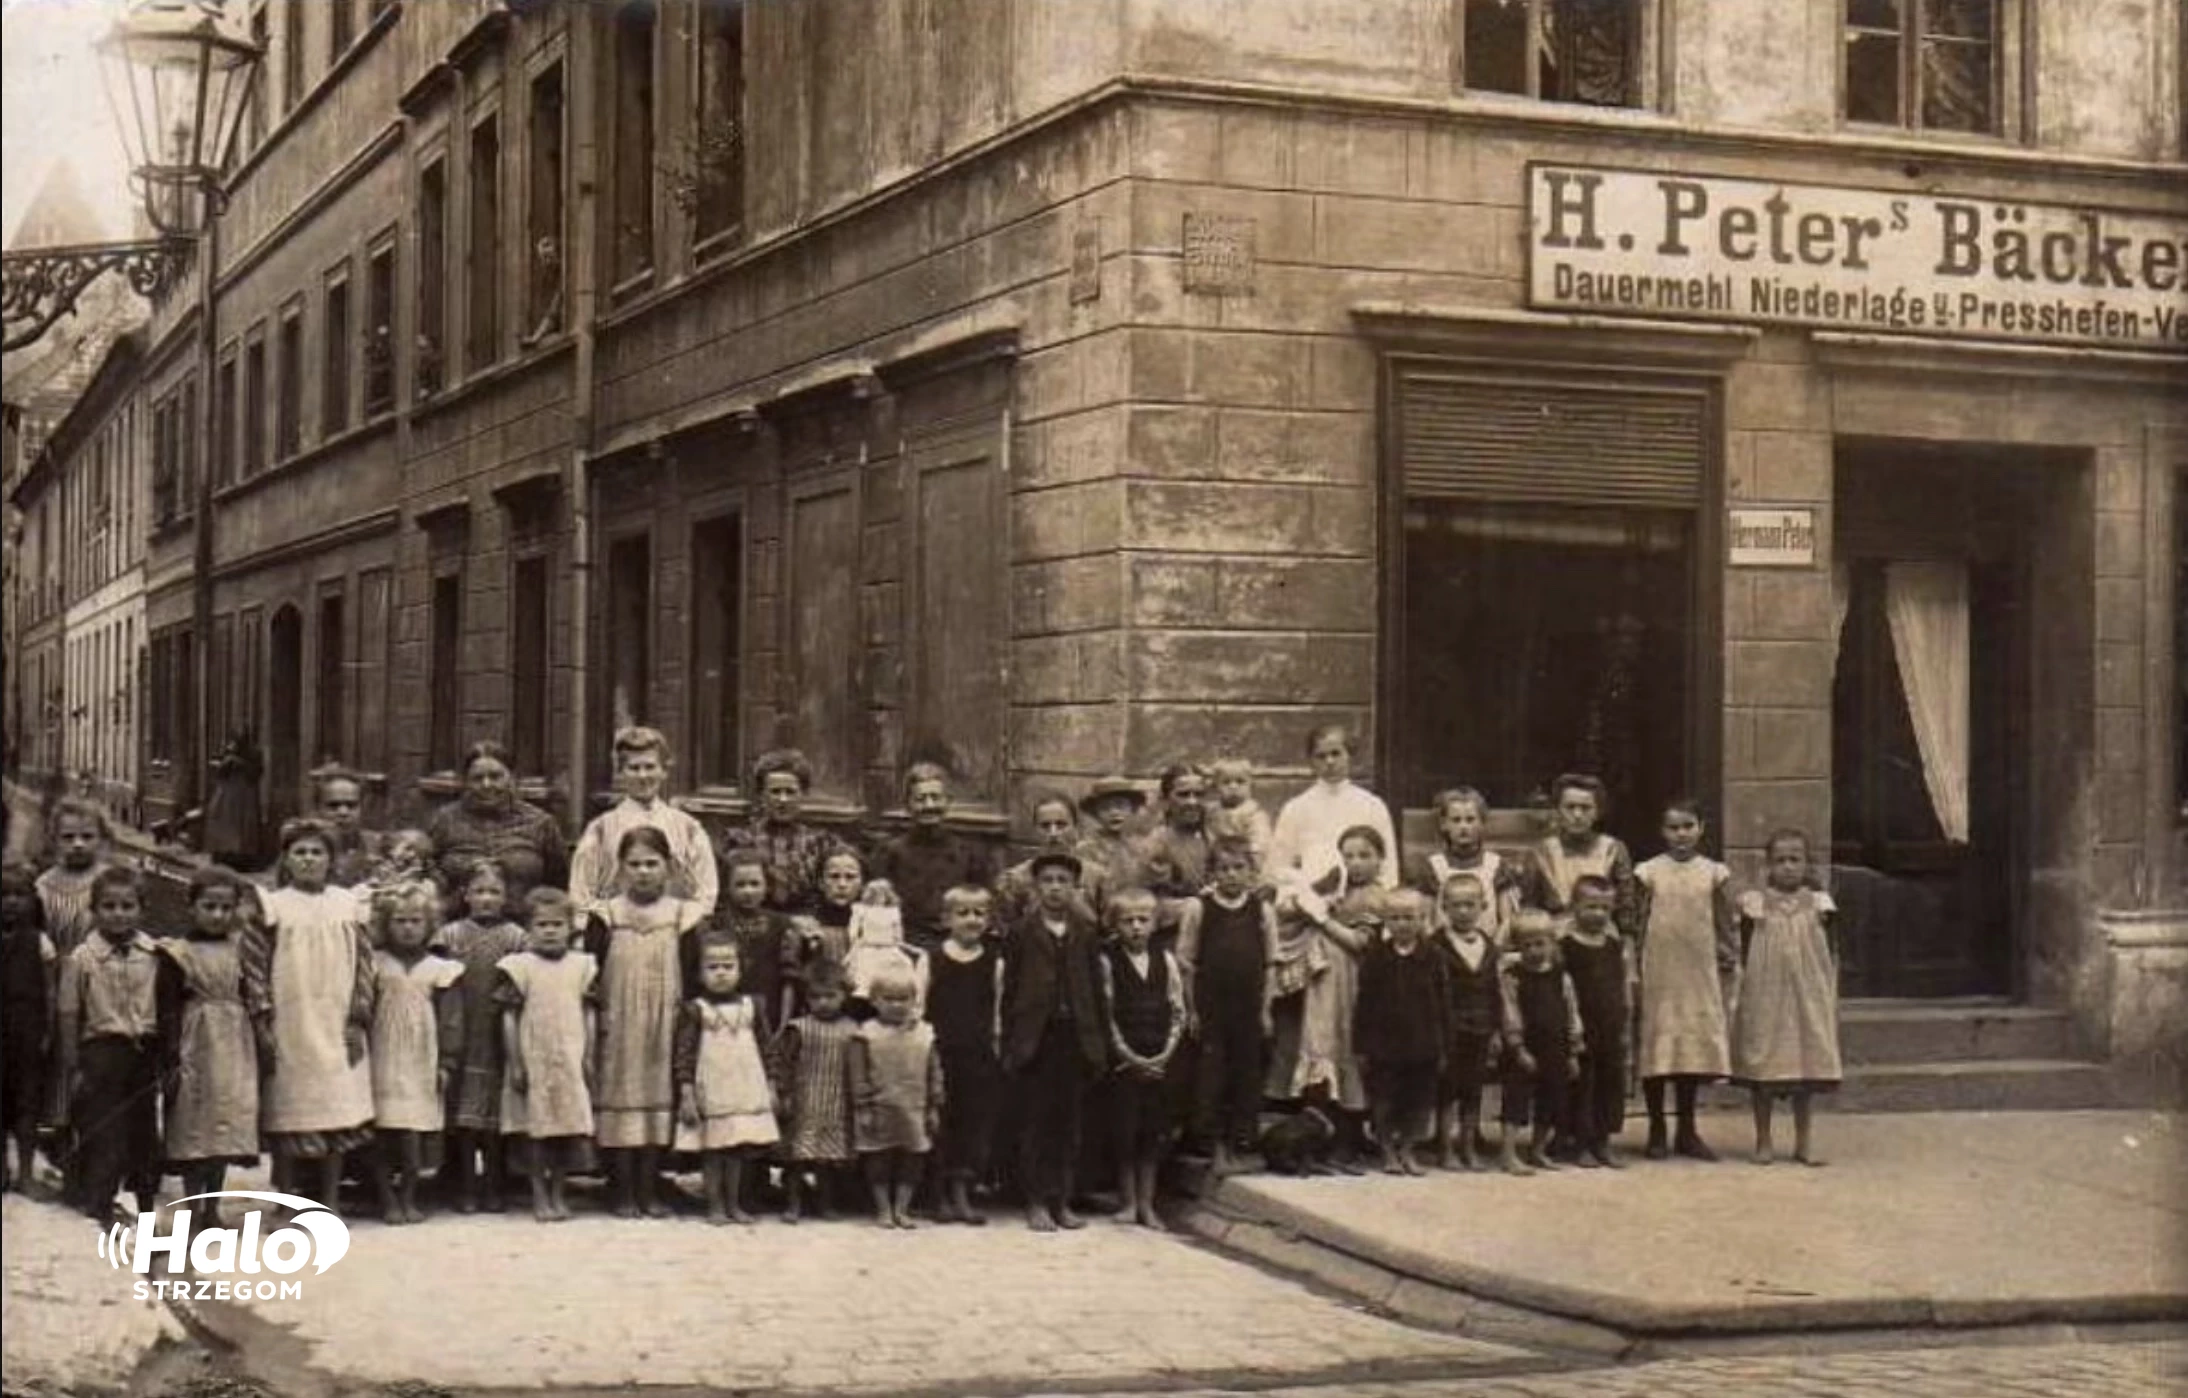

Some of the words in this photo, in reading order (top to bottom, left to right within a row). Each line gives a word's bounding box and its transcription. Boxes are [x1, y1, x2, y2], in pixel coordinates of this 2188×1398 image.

[1541, 170, 1633, 252] H.
[1554, 263, 1732, 311] Dauermehl
[1750, 277, 1925, 327] Niederlage
[1959, 292, 2188, 342] Presshefen-Ve
